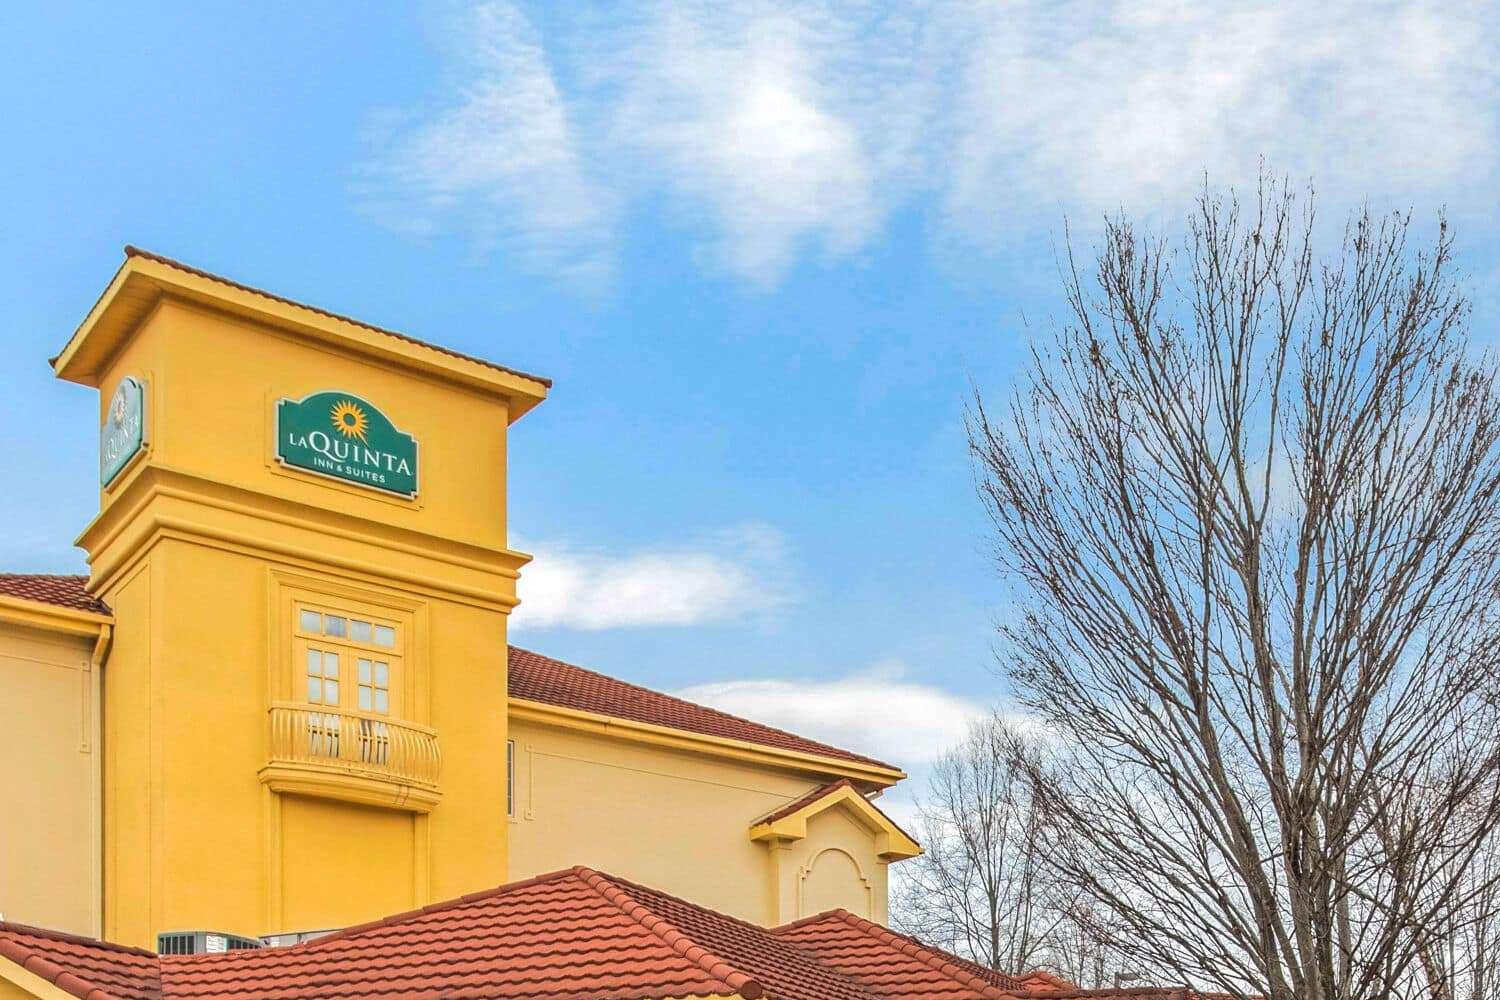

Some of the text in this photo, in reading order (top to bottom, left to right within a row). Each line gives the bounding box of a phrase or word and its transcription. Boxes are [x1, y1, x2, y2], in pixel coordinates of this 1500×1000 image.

[289, 431, 412, 476] LA QUINTA
[313, 457, 386, 483] INN & SUITES
